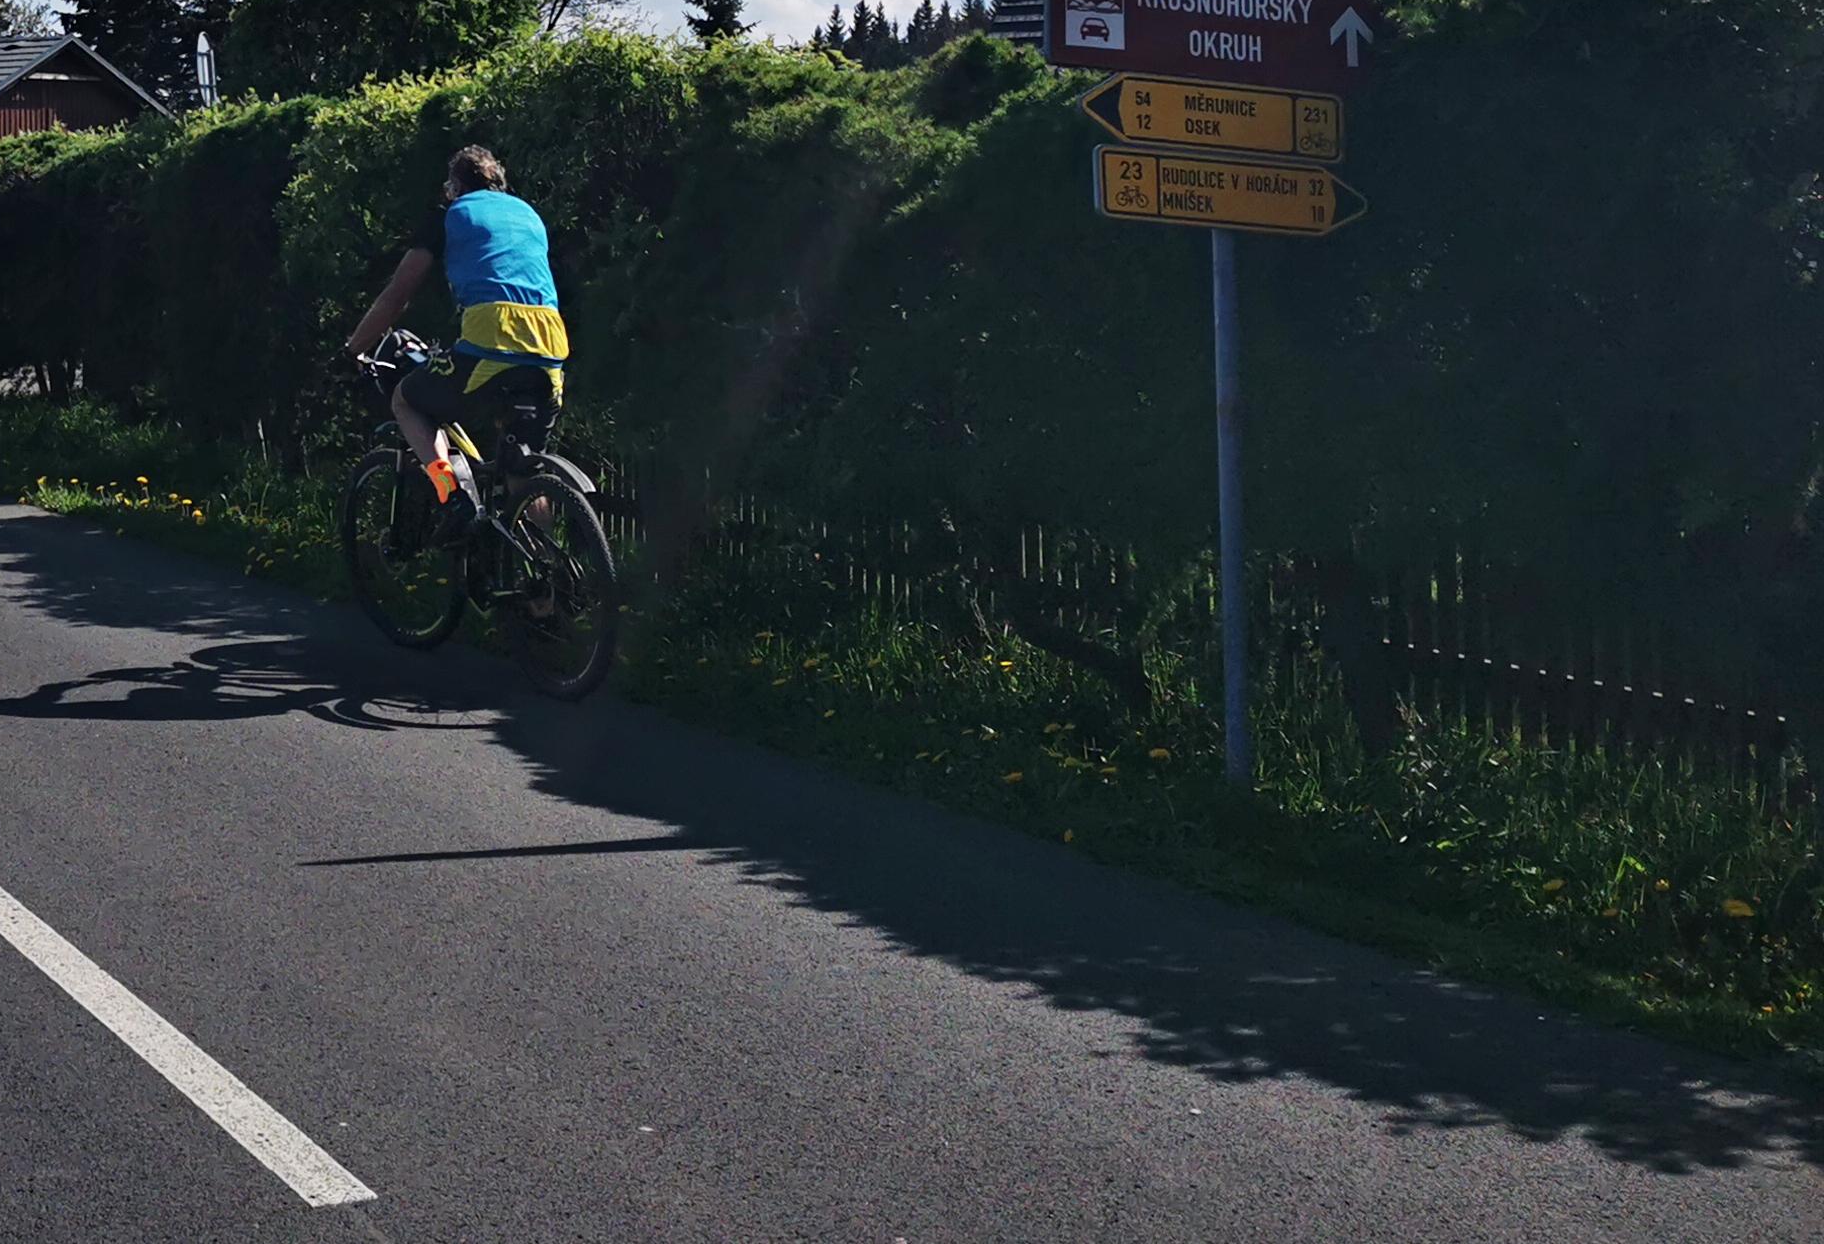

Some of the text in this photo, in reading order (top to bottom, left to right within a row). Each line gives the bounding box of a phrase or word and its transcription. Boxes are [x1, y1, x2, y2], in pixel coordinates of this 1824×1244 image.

[1189, 30, 1262, 62] OKRUH
[1184, 92, 1257, 117] MĚRUNICE
[1304, 107, 1329, 124] 231
[1136, 114, 1220, 136] 12 OSEK
[1120, 161, 1143, 181] 23
[1162, 167, 1324, 197] RUDOLICE V HORÁCH 32
[1162, 189, 1214, 213] MNÍŠEK
